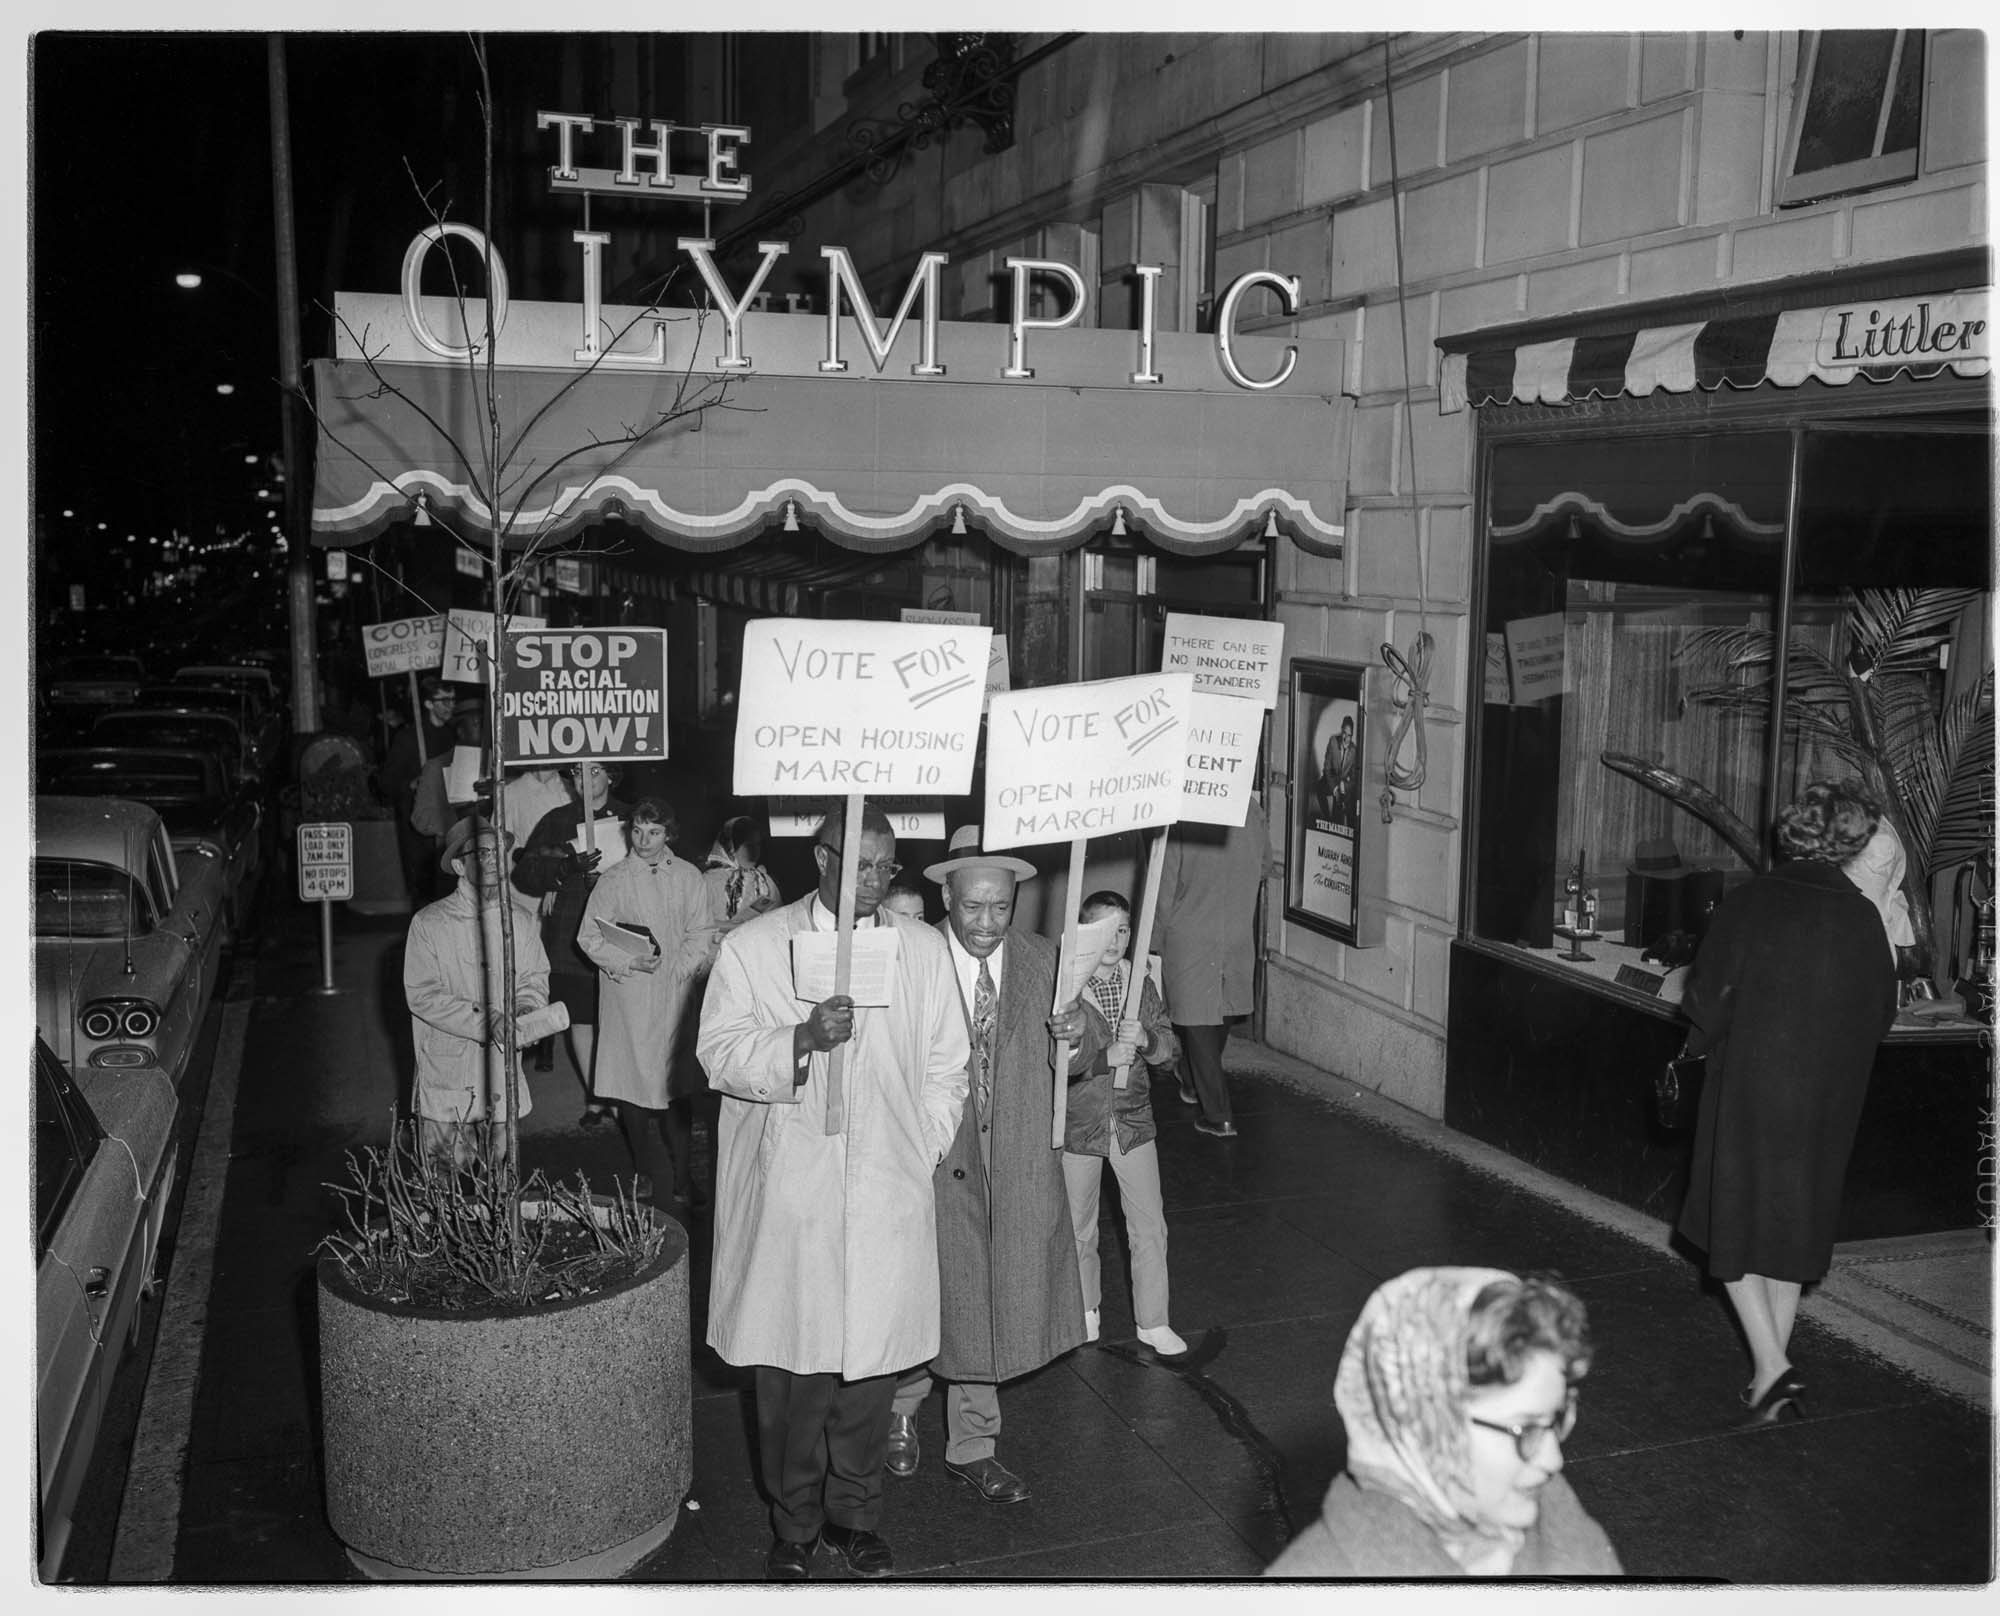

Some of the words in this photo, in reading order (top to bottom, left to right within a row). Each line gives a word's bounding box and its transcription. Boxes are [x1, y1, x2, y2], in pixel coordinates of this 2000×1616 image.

[537, 111, 752, 192] THE
[400, 221, 1300, 391] OLYMPIC
[1832, 302, 1986, 360] Littler
[371, 618, 446, 642] CORE
[515, 634, 638, 668] STOP
[1170, 636, 1216, 650] THERE
[1223, 641, 1247, 653] CAN
[1252, 643, 1270, 655] BE
[453, 655, 480, 671] TO
[773, 636, 876, 683] VOTE
[892, 639, 966, 689] FOR
[1170, 653, 1188, 665] NO
[1196, 655, 1269, 672] INNOCENT
[540, 669, 627, 689] RACIAL
[503, 689, 659, 717] DISCRIMINATION
[1013, 708, 1100, 747] VOTE
[1113, 688, 1172, 740] FOR
[518, 717, 650, 756] NOW!
[754, 725, 842, 748] OPEN
[860, 728, 965, 752] HOUSING
[1187, 727, 1212, 745] AN
[1221, 731, 1243, 747] BE
[773, 760, 893, 784] MARCH
[915, 765, 941, 785] 10
[1187, 754, 1242, 773] CENT
[998, 782, 1072, 809] OPEN
[1089, 770, 1172, 798] HOUSING
[901, 815, 920, 831] 10
[1015, 805, 1115, 836] MARCH
[1132, 802, 1153, 821] 10
